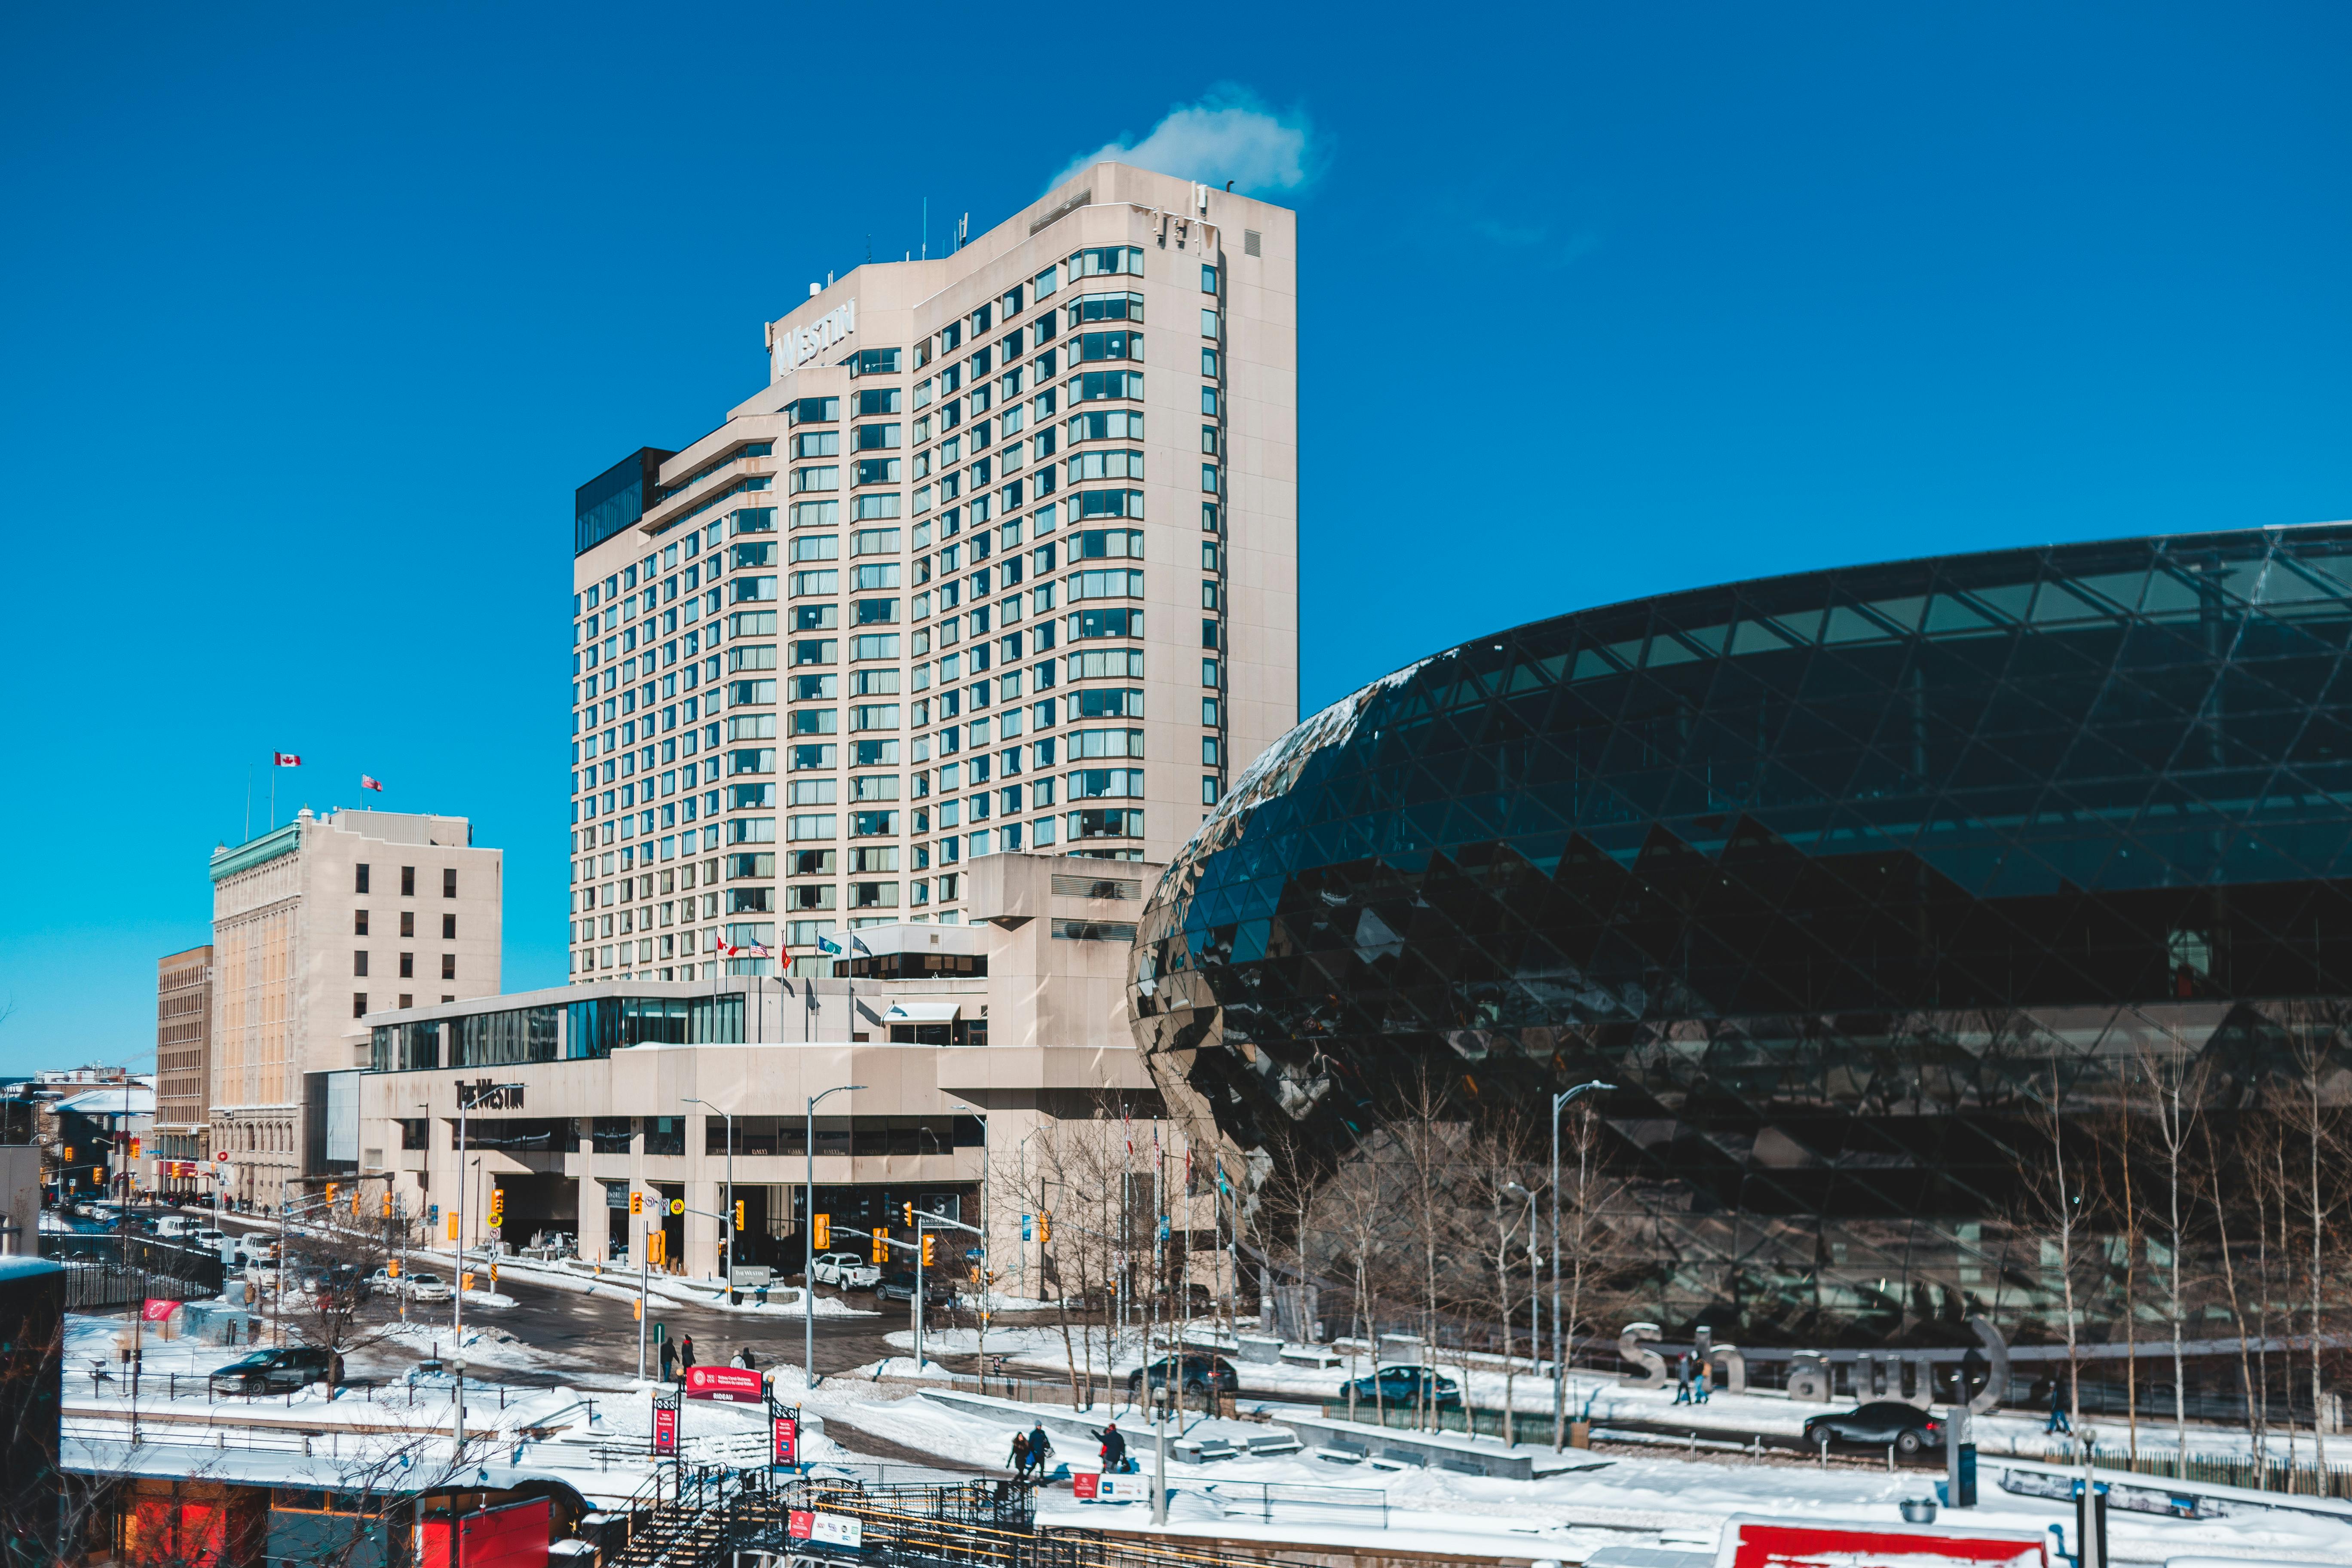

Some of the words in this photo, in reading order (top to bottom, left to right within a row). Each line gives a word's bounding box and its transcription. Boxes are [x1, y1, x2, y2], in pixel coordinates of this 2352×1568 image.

[773, 297, 856, 377] WESTIN
[454, 1080, 477, 1109] THE
[476, 1078, 524, 1109] WESTIN
[713, 1393, 733, 1401] RIDEAU
